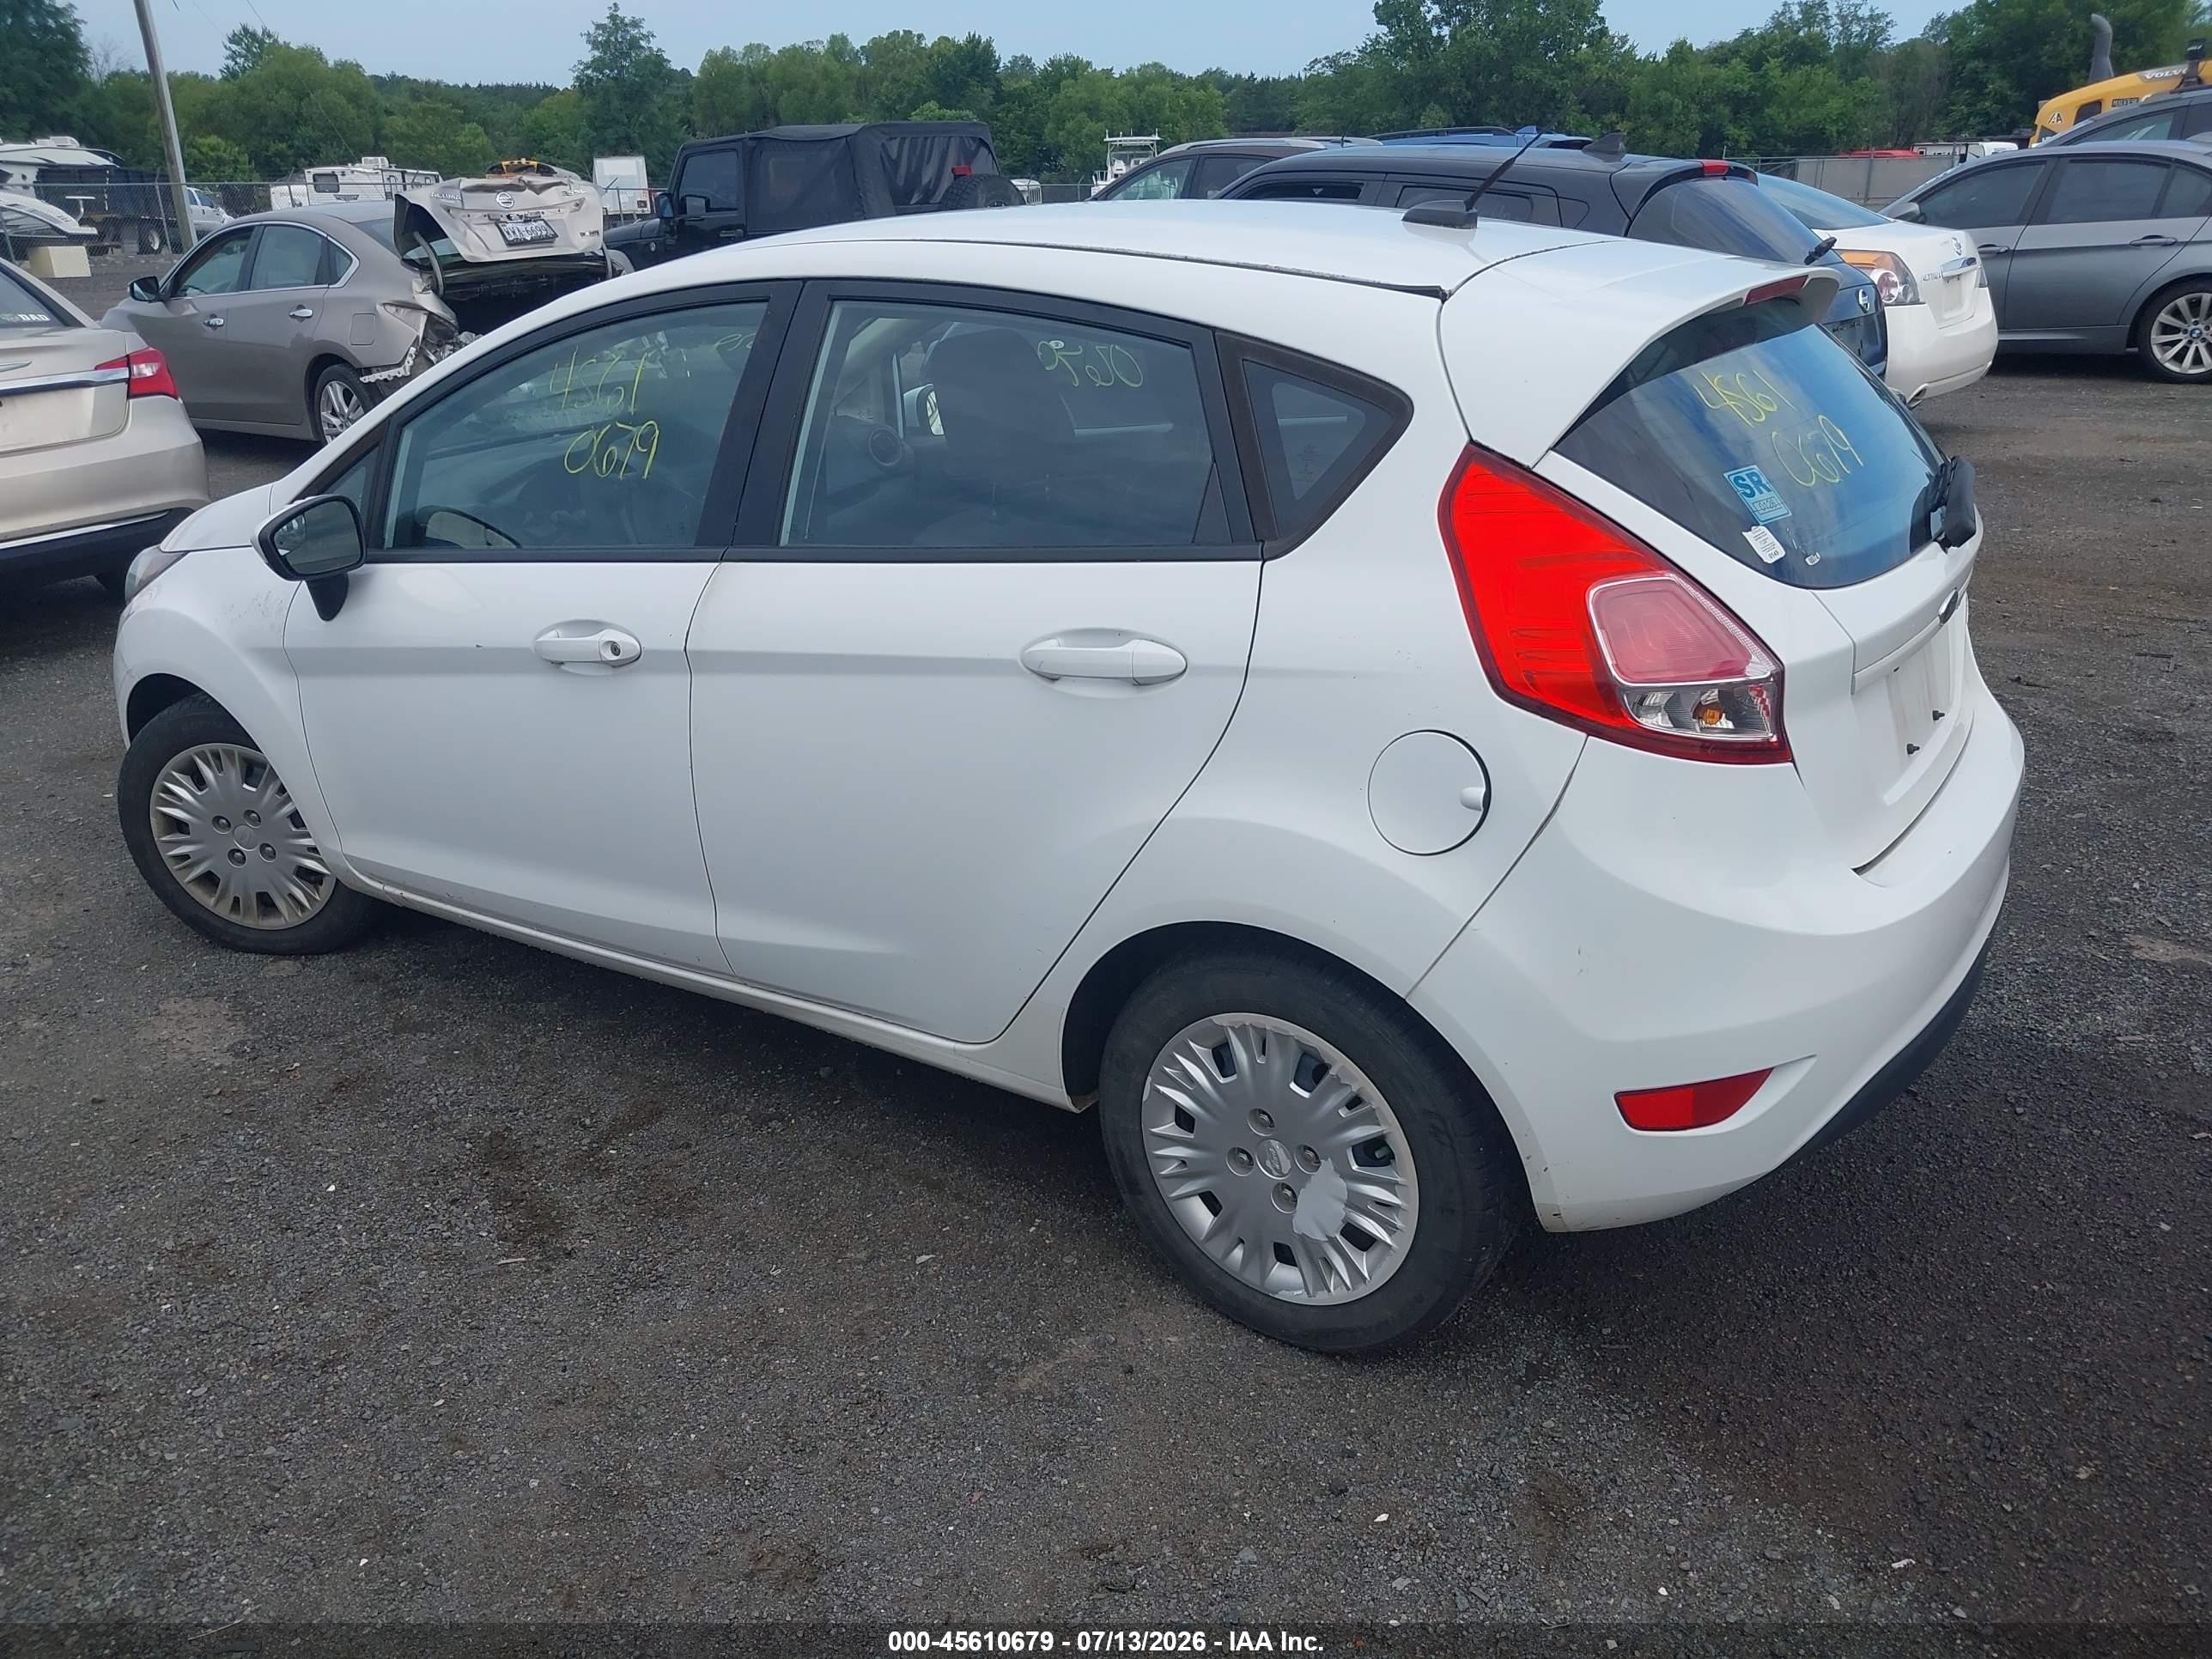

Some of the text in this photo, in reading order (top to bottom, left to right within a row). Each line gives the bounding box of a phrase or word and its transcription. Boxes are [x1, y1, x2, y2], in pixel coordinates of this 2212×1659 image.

[1692, 369, 1798, 428] 4561
[564, 420, 659, 480] 0679
[1771, 414, 1864, 487] 0679
[1733, 471, 1772, 498] SR
